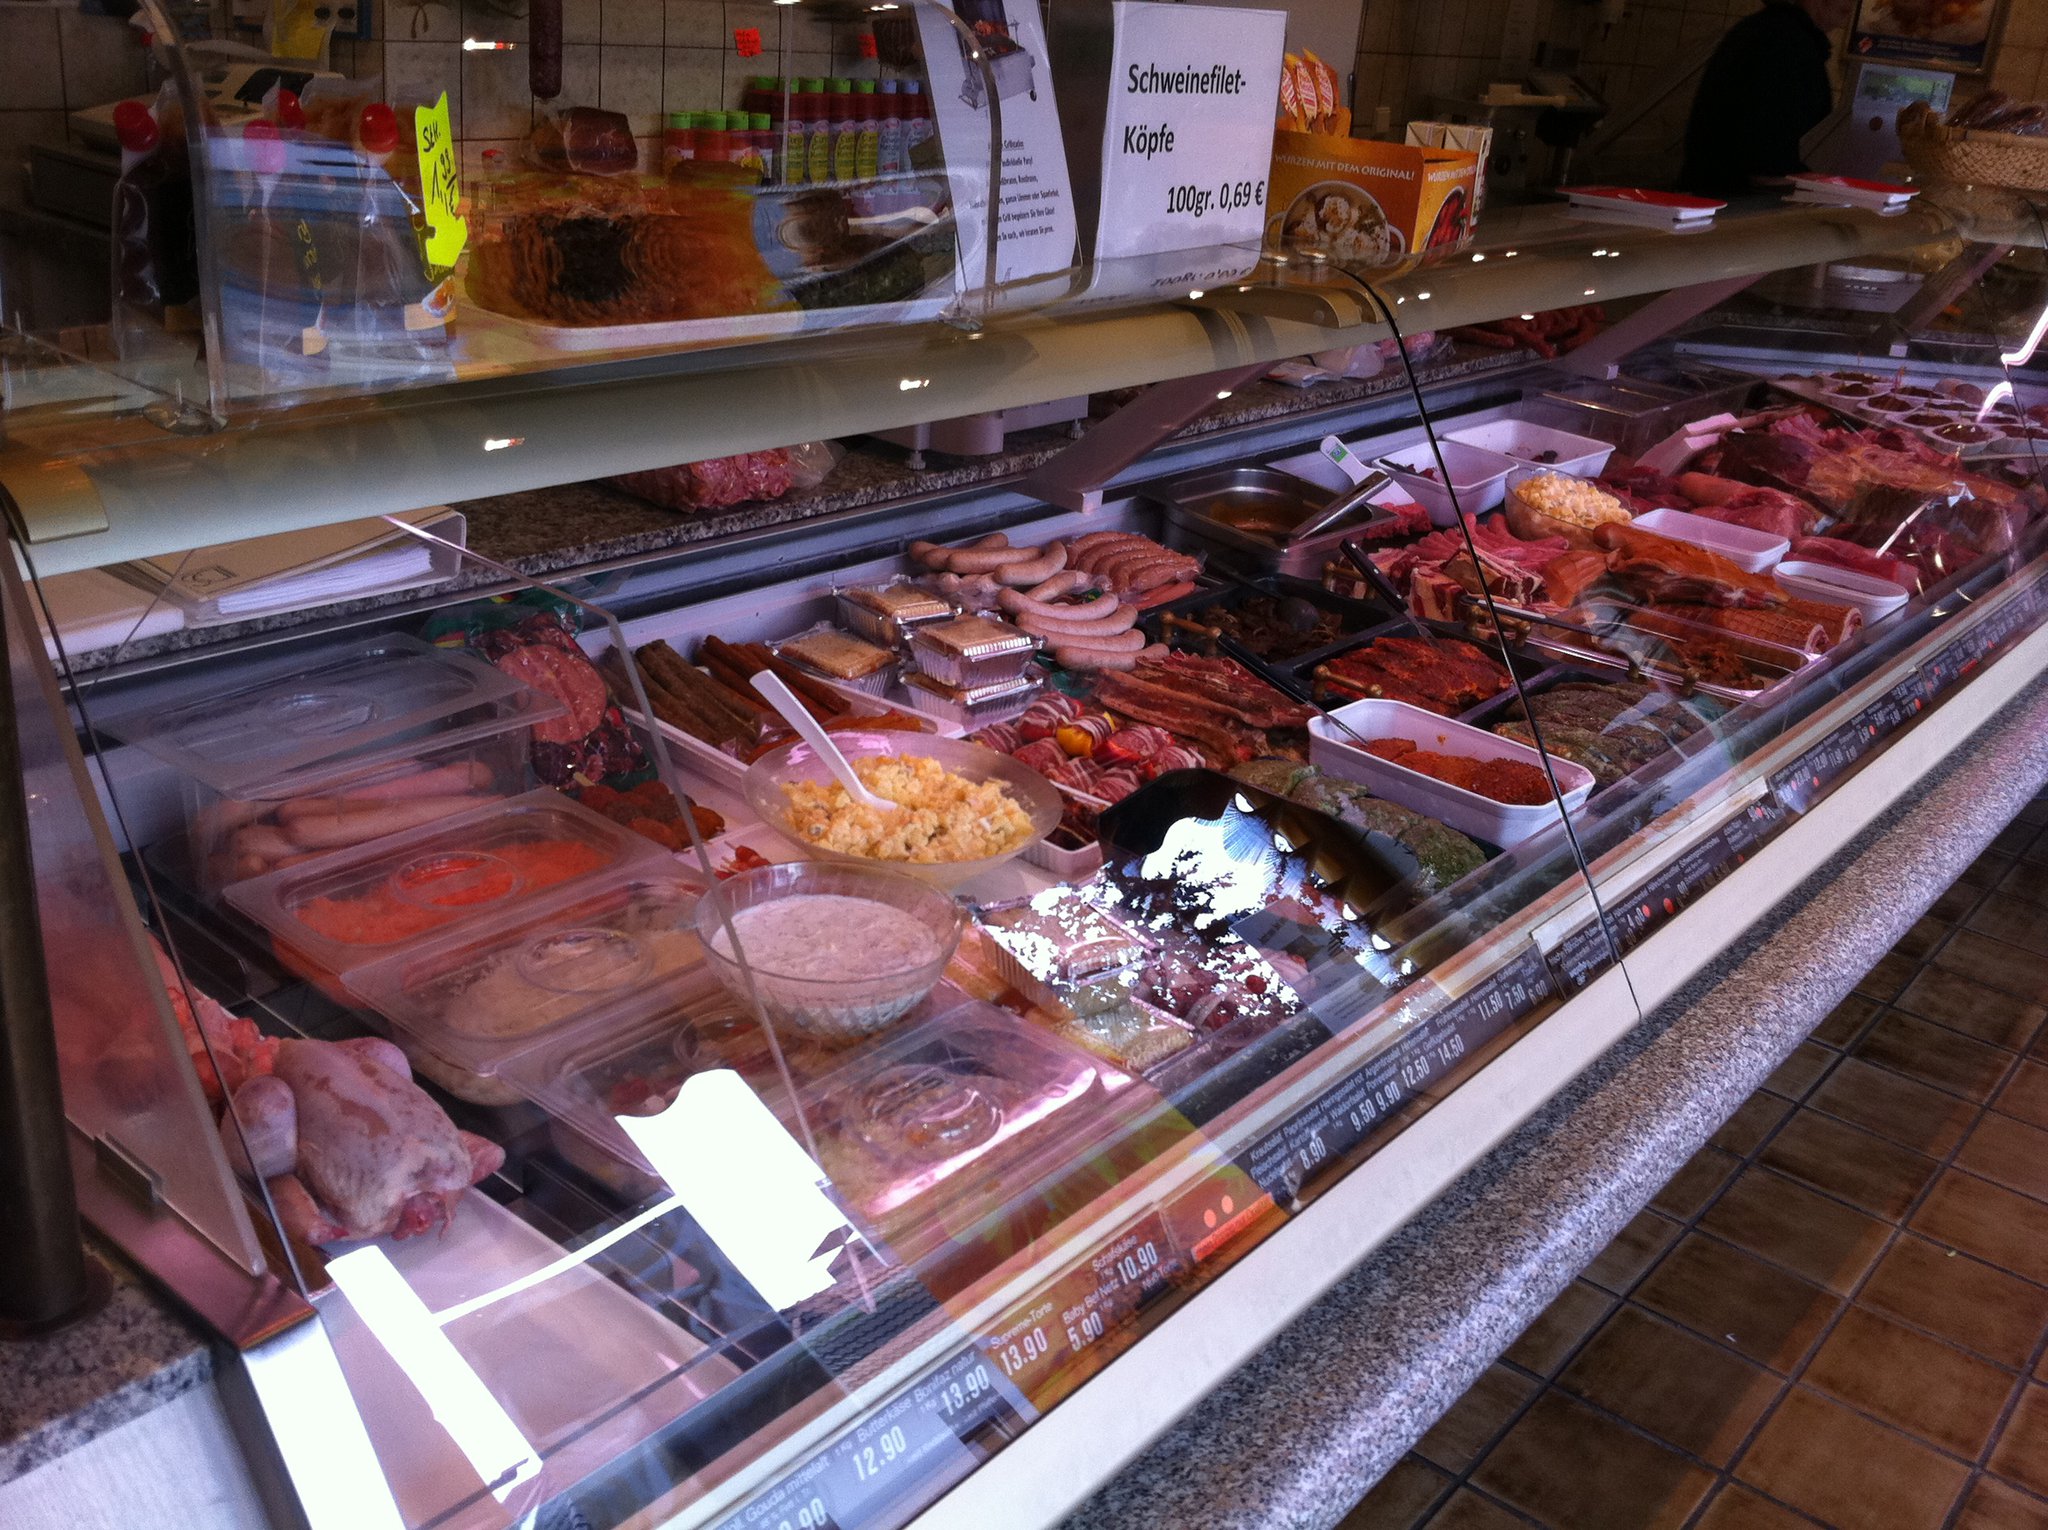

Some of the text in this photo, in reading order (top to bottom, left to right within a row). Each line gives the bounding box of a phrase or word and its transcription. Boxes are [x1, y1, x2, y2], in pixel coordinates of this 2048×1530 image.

[1127, 64, 1247, 94] Schweinefilet-
[1122, 122, 1175, 161] Köpfe
[1337, 162, 1359, 173] DEM
[1361, 166, 1415, 182] ORIGINAL!
[1166, 180, 1266, 218] 100gr. 0,69 €
[1477, 990, 1504, 1022] 11.50
[1504, 982, 1527, 1010] 7.50
[1299, 1033, 1466, 1170] 8.90 9.50 9.90 12.50 14.50
[1250, 1132, 1284, 1161] Krautsalat
[1117, 1240, 1159, 1286] 10.90
[1000, 1311, 1104, 1376] 13.90 5.90
[941, 1363, 990, 1416] 13.90
[856, 1398, 913, 1443] Butterkäse
[852, 1425, 907, 1482] 12.90
[745, 1487, 786, 1522] Gouda
